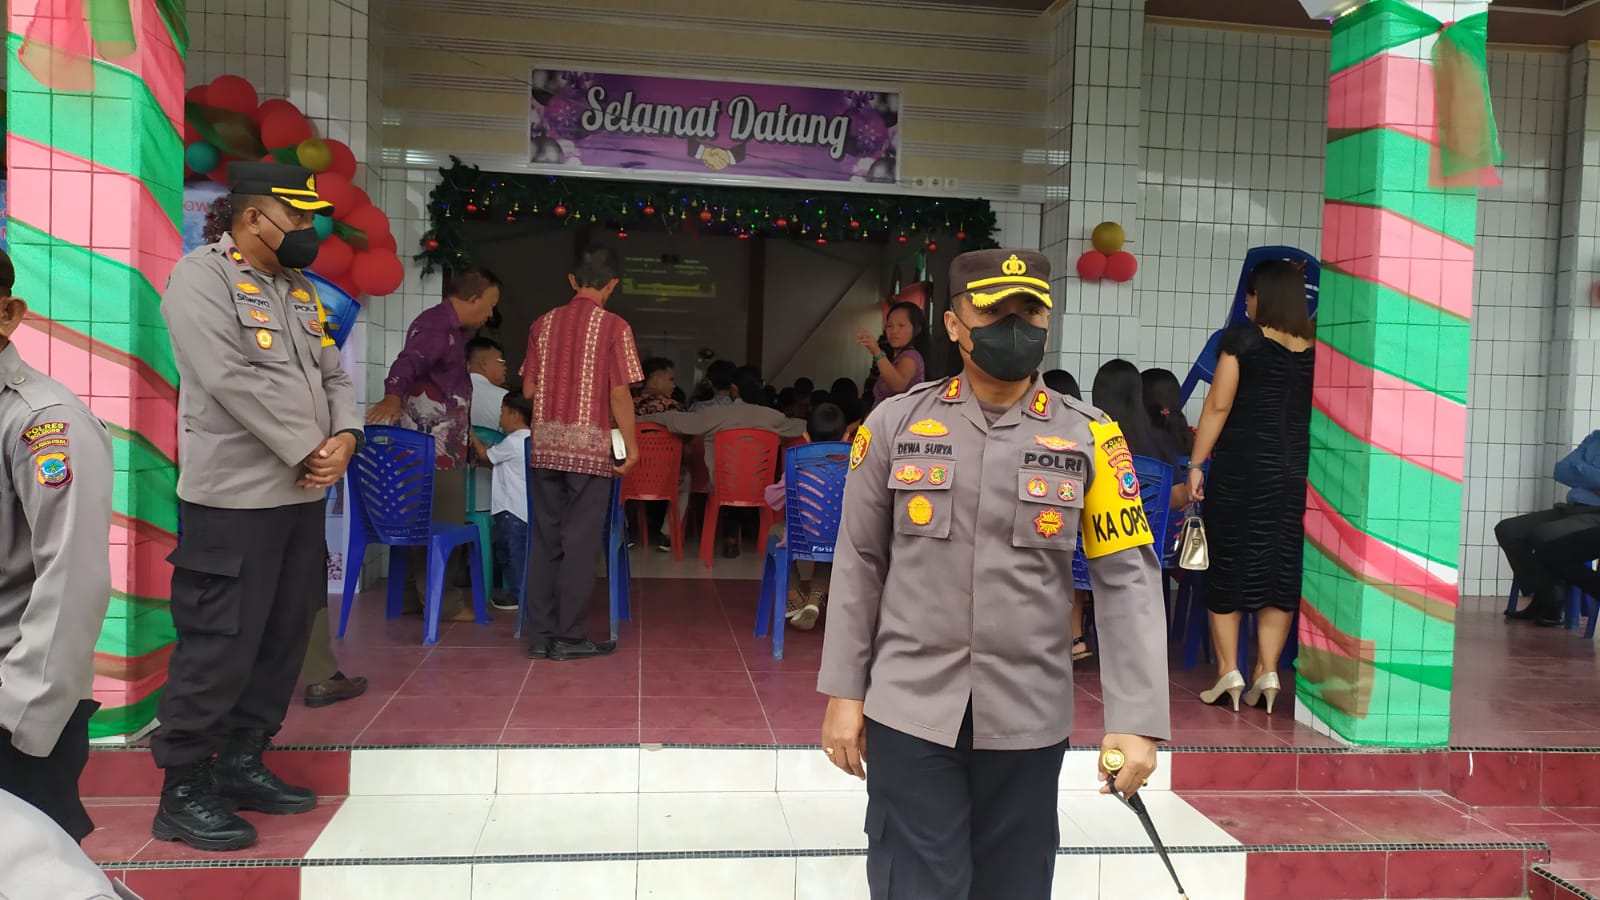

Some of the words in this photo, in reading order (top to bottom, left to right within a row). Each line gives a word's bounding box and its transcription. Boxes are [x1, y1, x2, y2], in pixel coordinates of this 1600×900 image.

[582, 86, 720, 137] Selamat
[728, 96, 849, 159] Datang
[25, 422, 64, 438] POLRES
[897, 442, 920, 454] DEWA
[924, 443, 953, 455] SURYA
[1024, 452, 1082, 471] POLRI
[1092, 511, 1120, 543] KA
[1120, 505, 1149, 537] OPS
